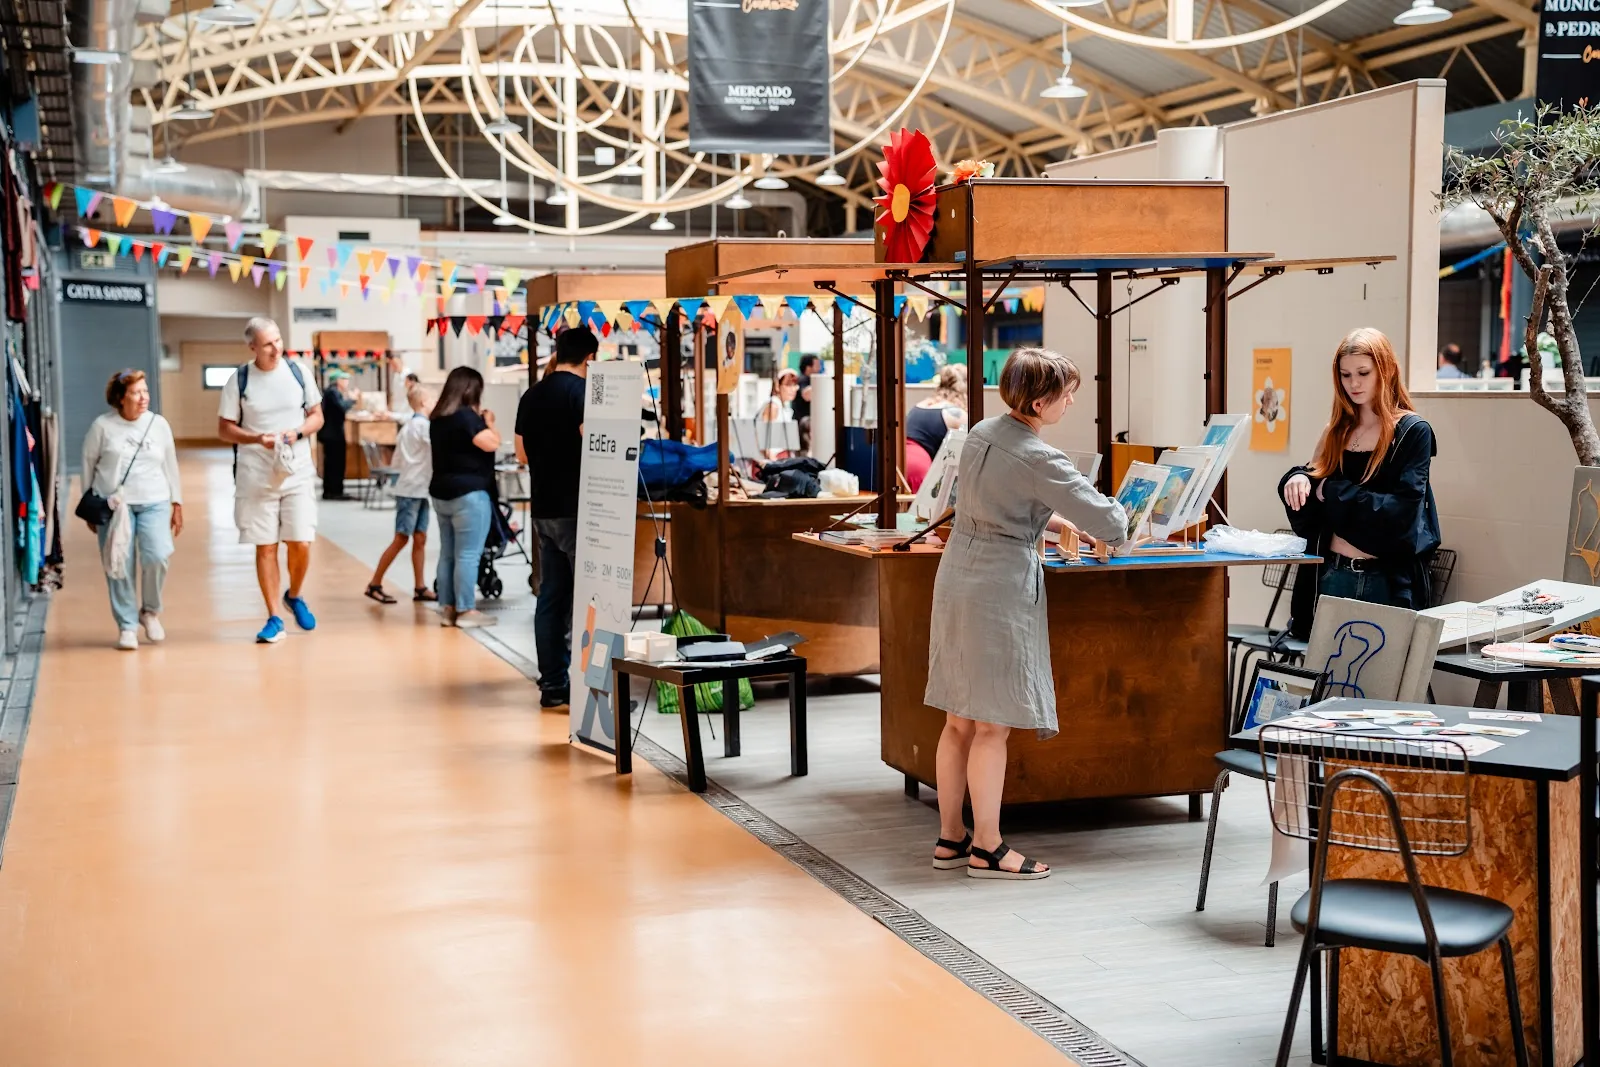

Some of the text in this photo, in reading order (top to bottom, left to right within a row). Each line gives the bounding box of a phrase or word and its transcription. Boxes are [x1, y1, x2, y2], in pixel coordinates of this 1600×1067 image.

[1544, 0, 1600, 12] MUNIC
[1557, 21, 1600, 37] PEDR
[728, 85, 792, 98] MERCADO
[589, 433, 616, 453] EdEra
[602, 564, 612, 577] 2M
